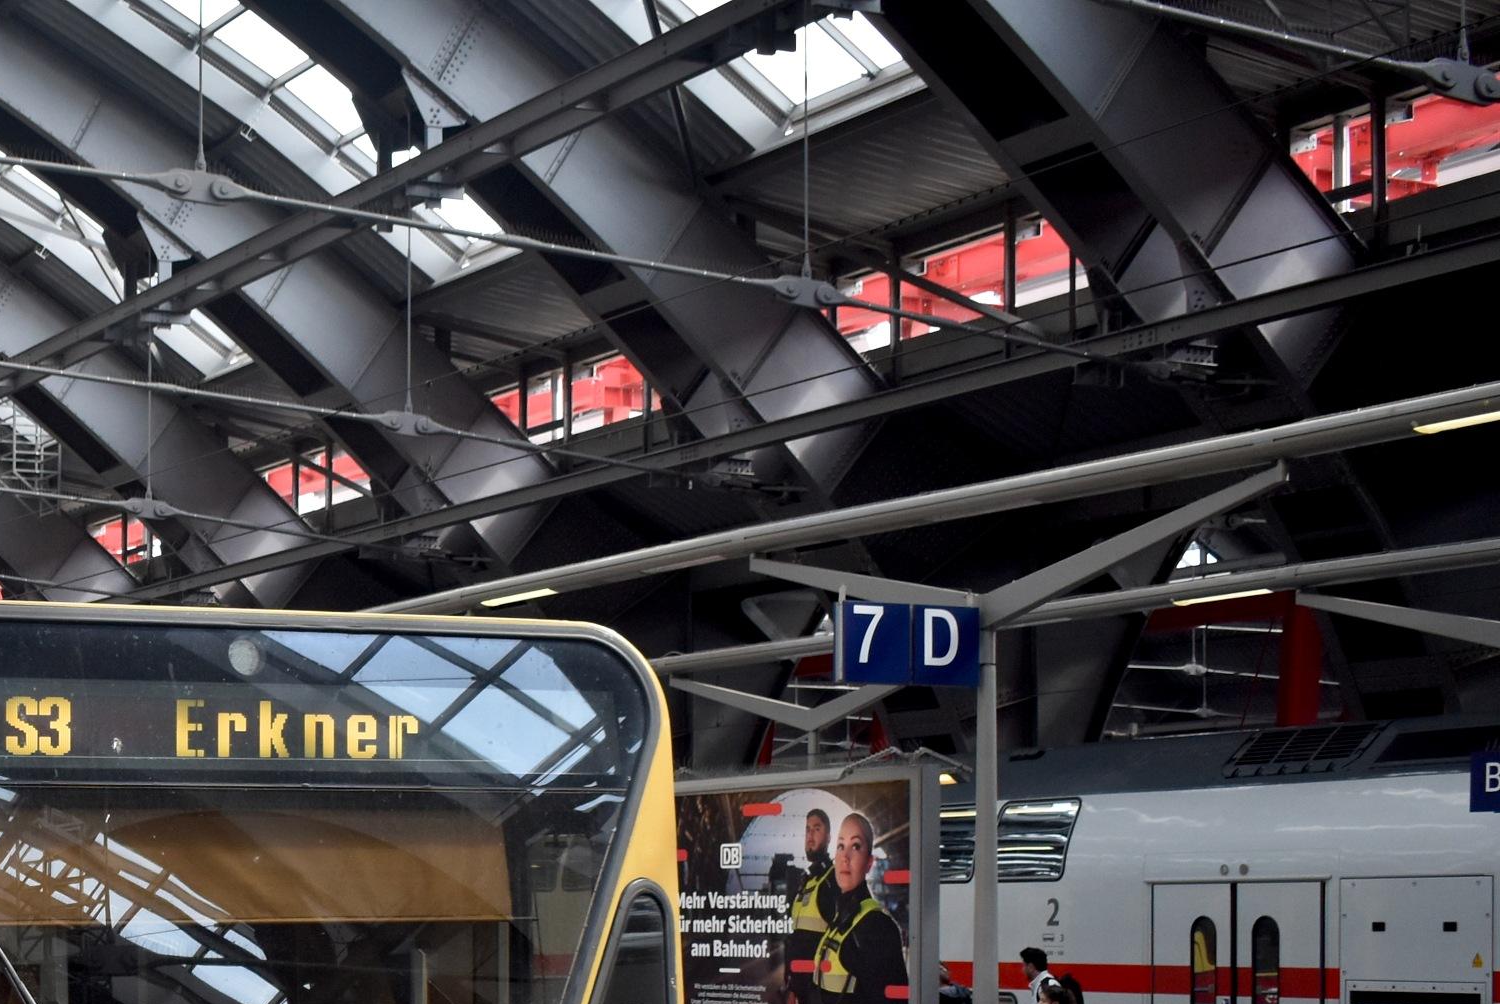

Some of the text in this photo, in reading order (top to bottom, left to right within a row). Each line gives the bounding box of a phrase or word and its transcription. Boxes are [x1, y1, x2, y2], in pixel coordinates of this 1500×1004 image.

[853, 604, 960, 667] 7 D
[5, 696, 419, 760] S3 Erkner
[722, 846, 740, 866] DB
[708, 891, 790, 913] Verstärkung.
[1046, 897, 1060, 927] 2
[679, 915, 794, 934] ür mehr Sicherheit
[691, 939, 771, 959] am Bahnhof.
